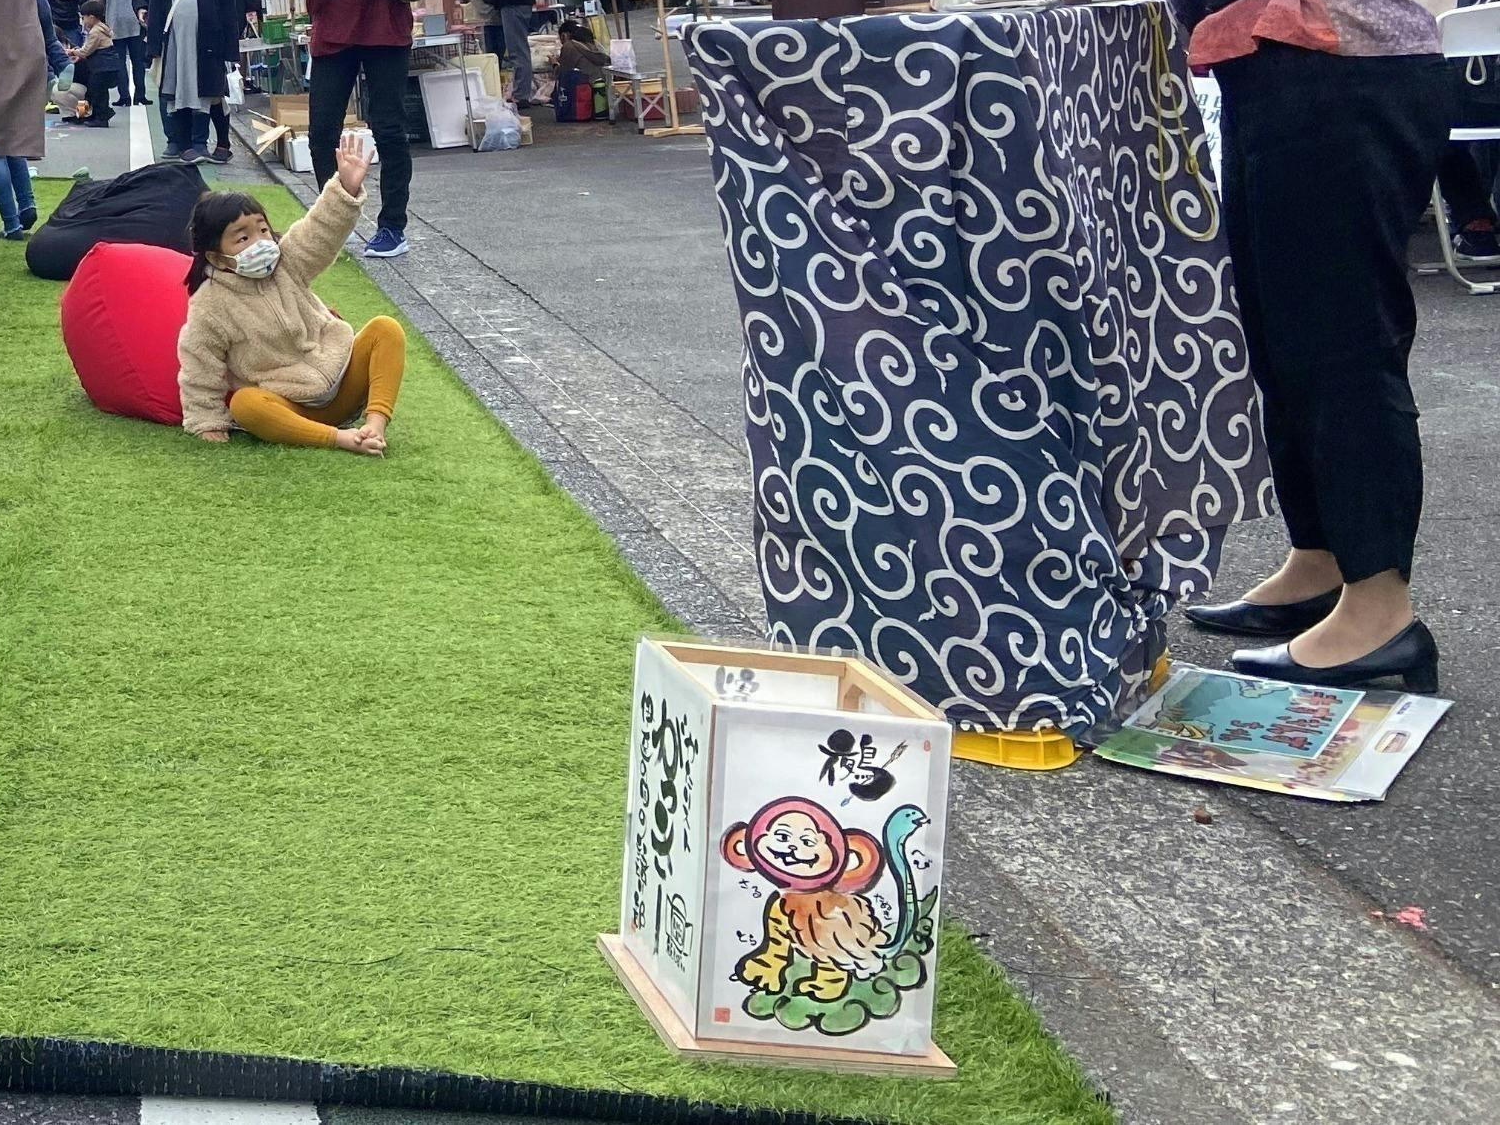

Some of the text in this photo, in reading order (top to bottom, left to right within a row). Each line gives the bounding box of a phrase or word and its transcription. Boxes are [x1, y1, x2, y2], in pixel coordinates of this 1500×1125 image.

[912, 849, 932, 870] へび
[739, 879, 762, 898] さる
[737, 931, 757, 946] とら
